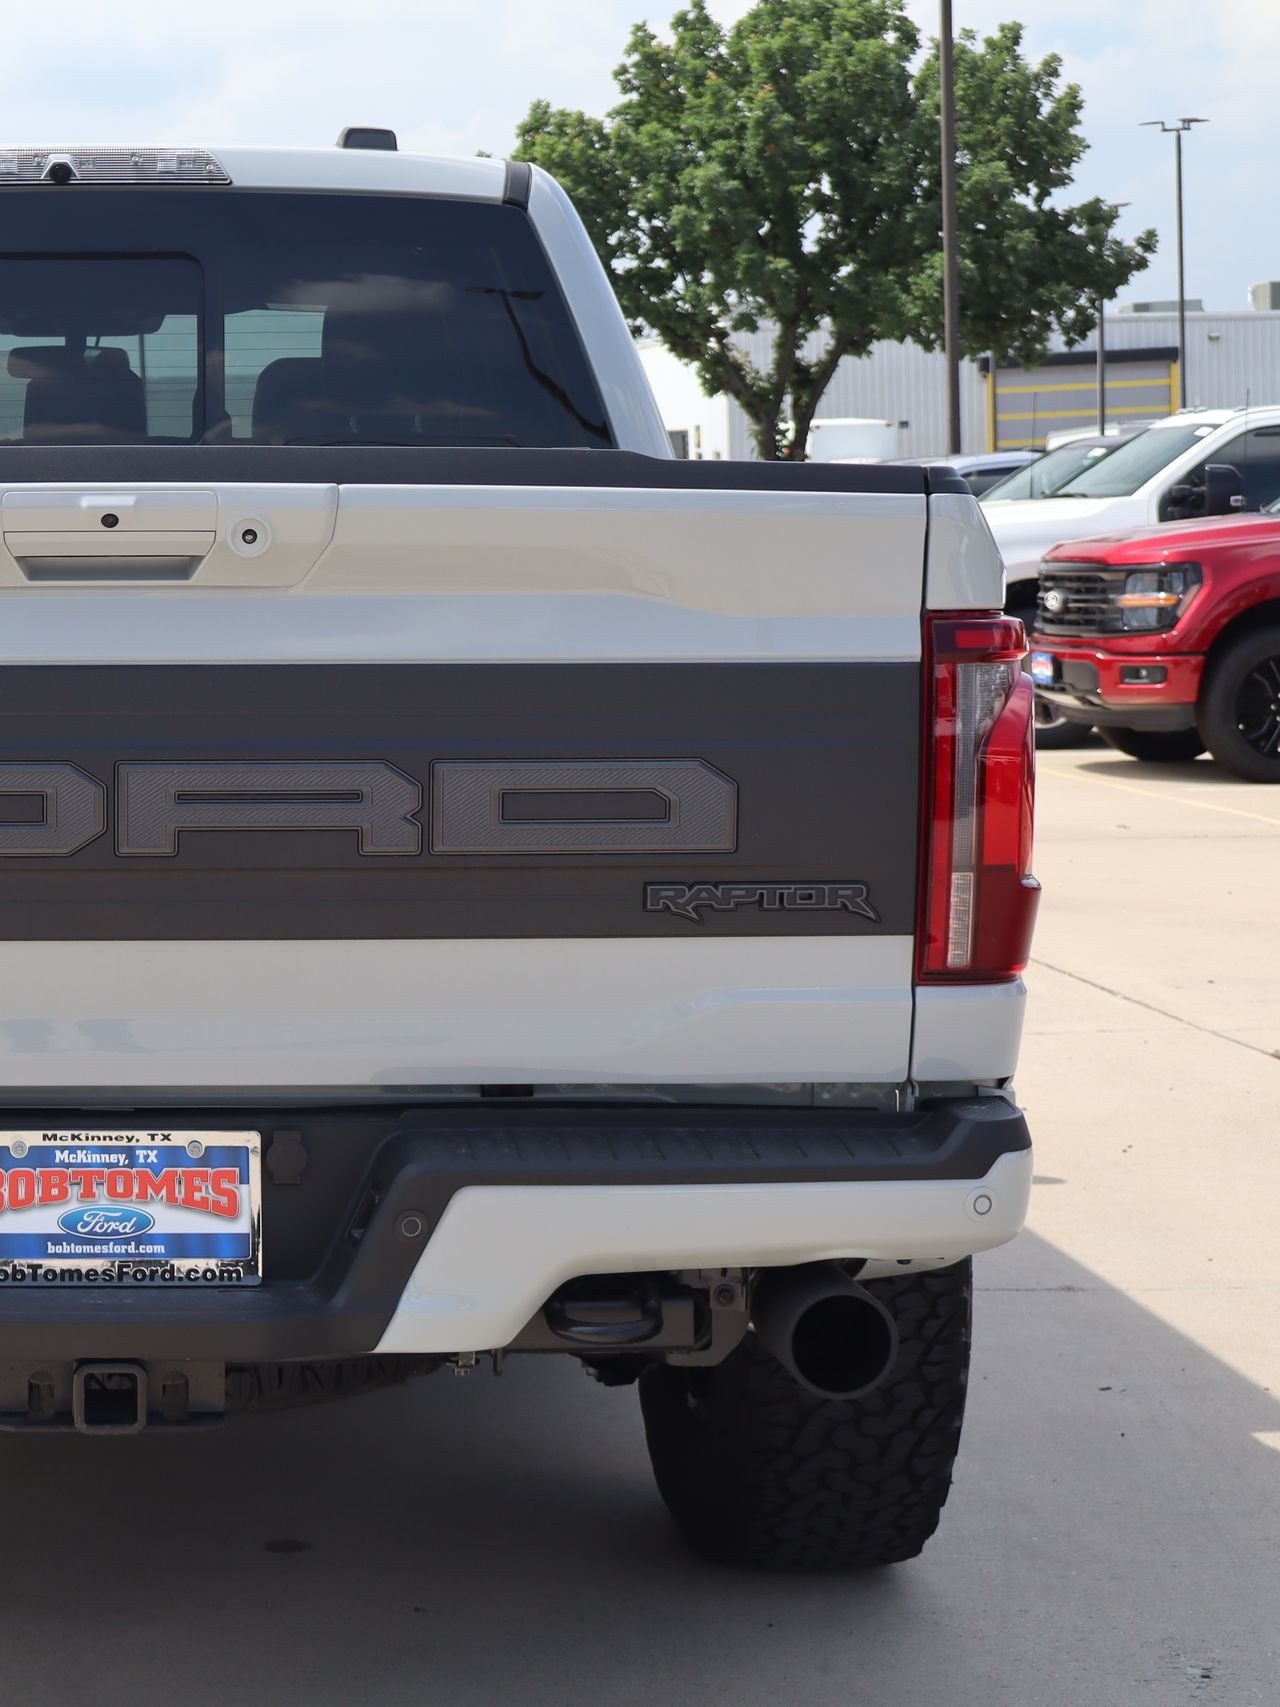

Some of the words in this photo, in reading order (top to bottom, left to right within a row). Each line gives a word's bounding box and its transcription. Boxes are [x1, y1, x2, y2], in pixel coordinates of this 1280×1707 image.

[643, 881, 881, 925] RAPTOR
[42, 1133, 140, 1142] McKinney,
[147, 1133, 172, 1142] TX
[55, 1150, 129, 1166] McKinney,
[136, 1150, 158, 1163] TX
[77, 1210, 137, 1234] Ford
[47, 1241, 166, 1254] bobtomesford.com
